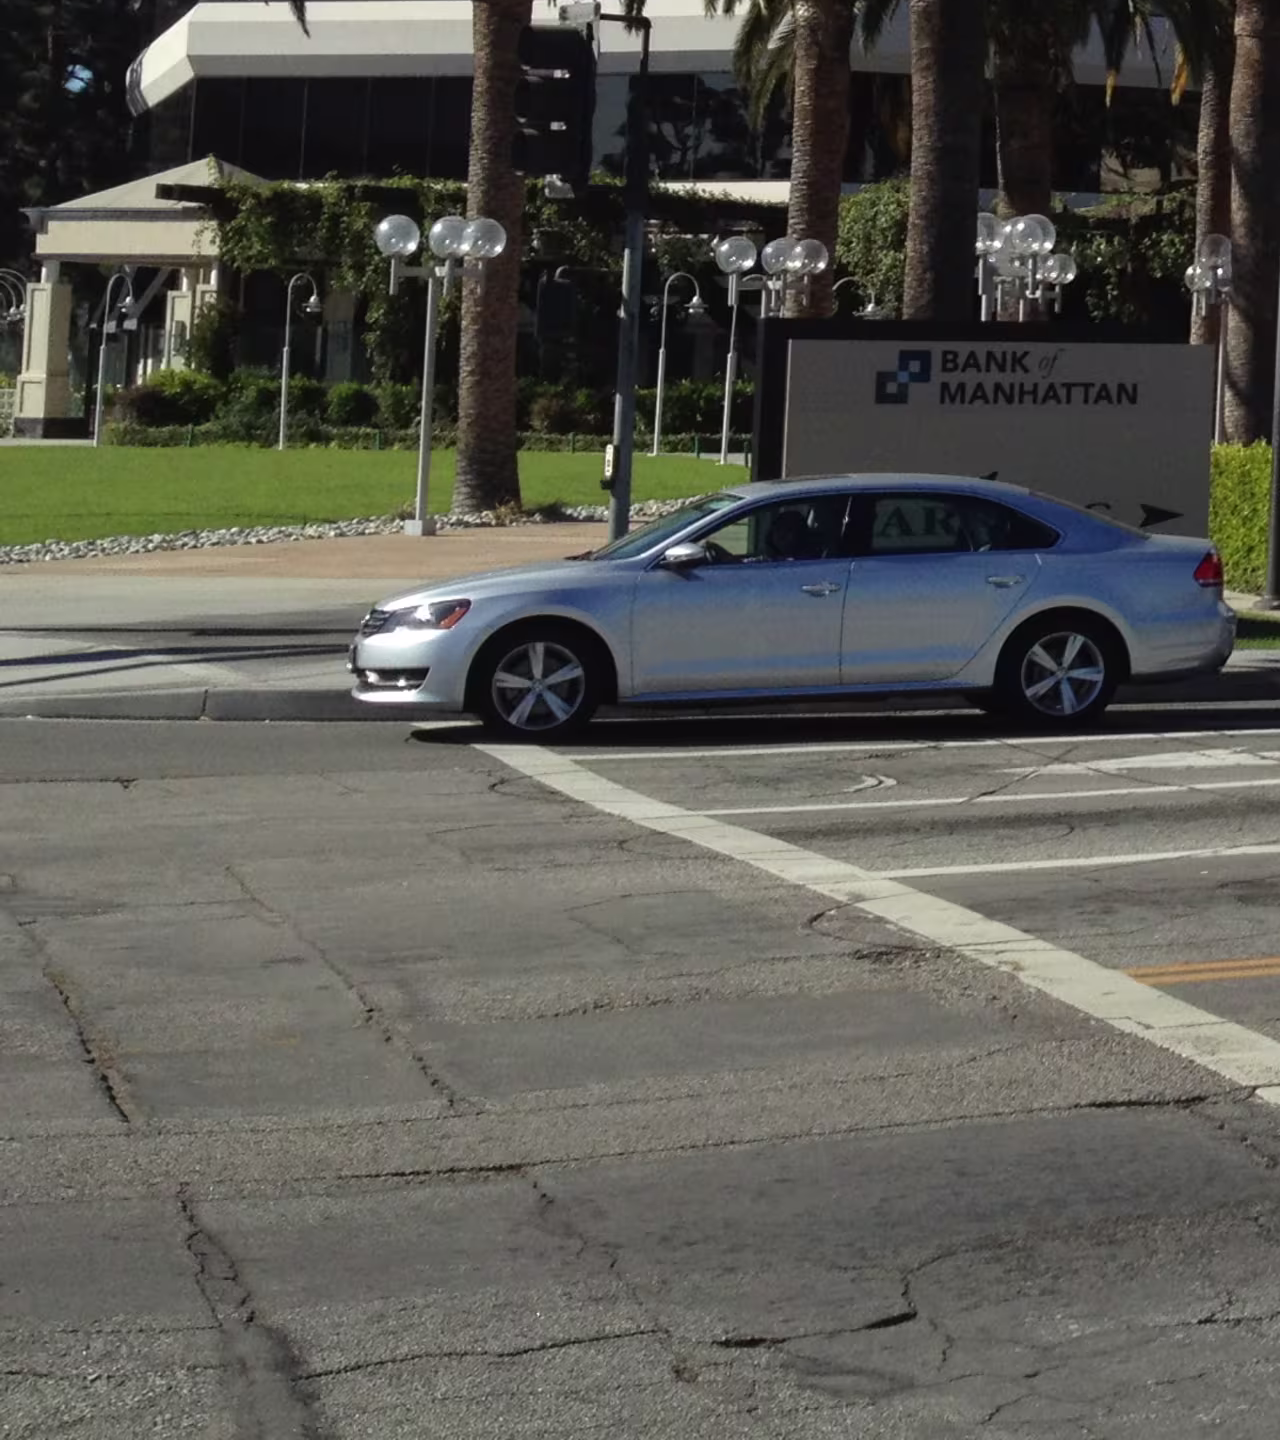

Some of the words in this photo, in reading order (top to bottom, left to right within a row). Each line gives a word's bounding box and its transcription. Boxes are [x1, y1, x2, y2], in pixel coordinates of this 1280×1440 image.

[941, 349, 1030, 374] BANK
[1038, 348, 1067, 379] of
[939, 382, 1139, 406] MANHATTAN
